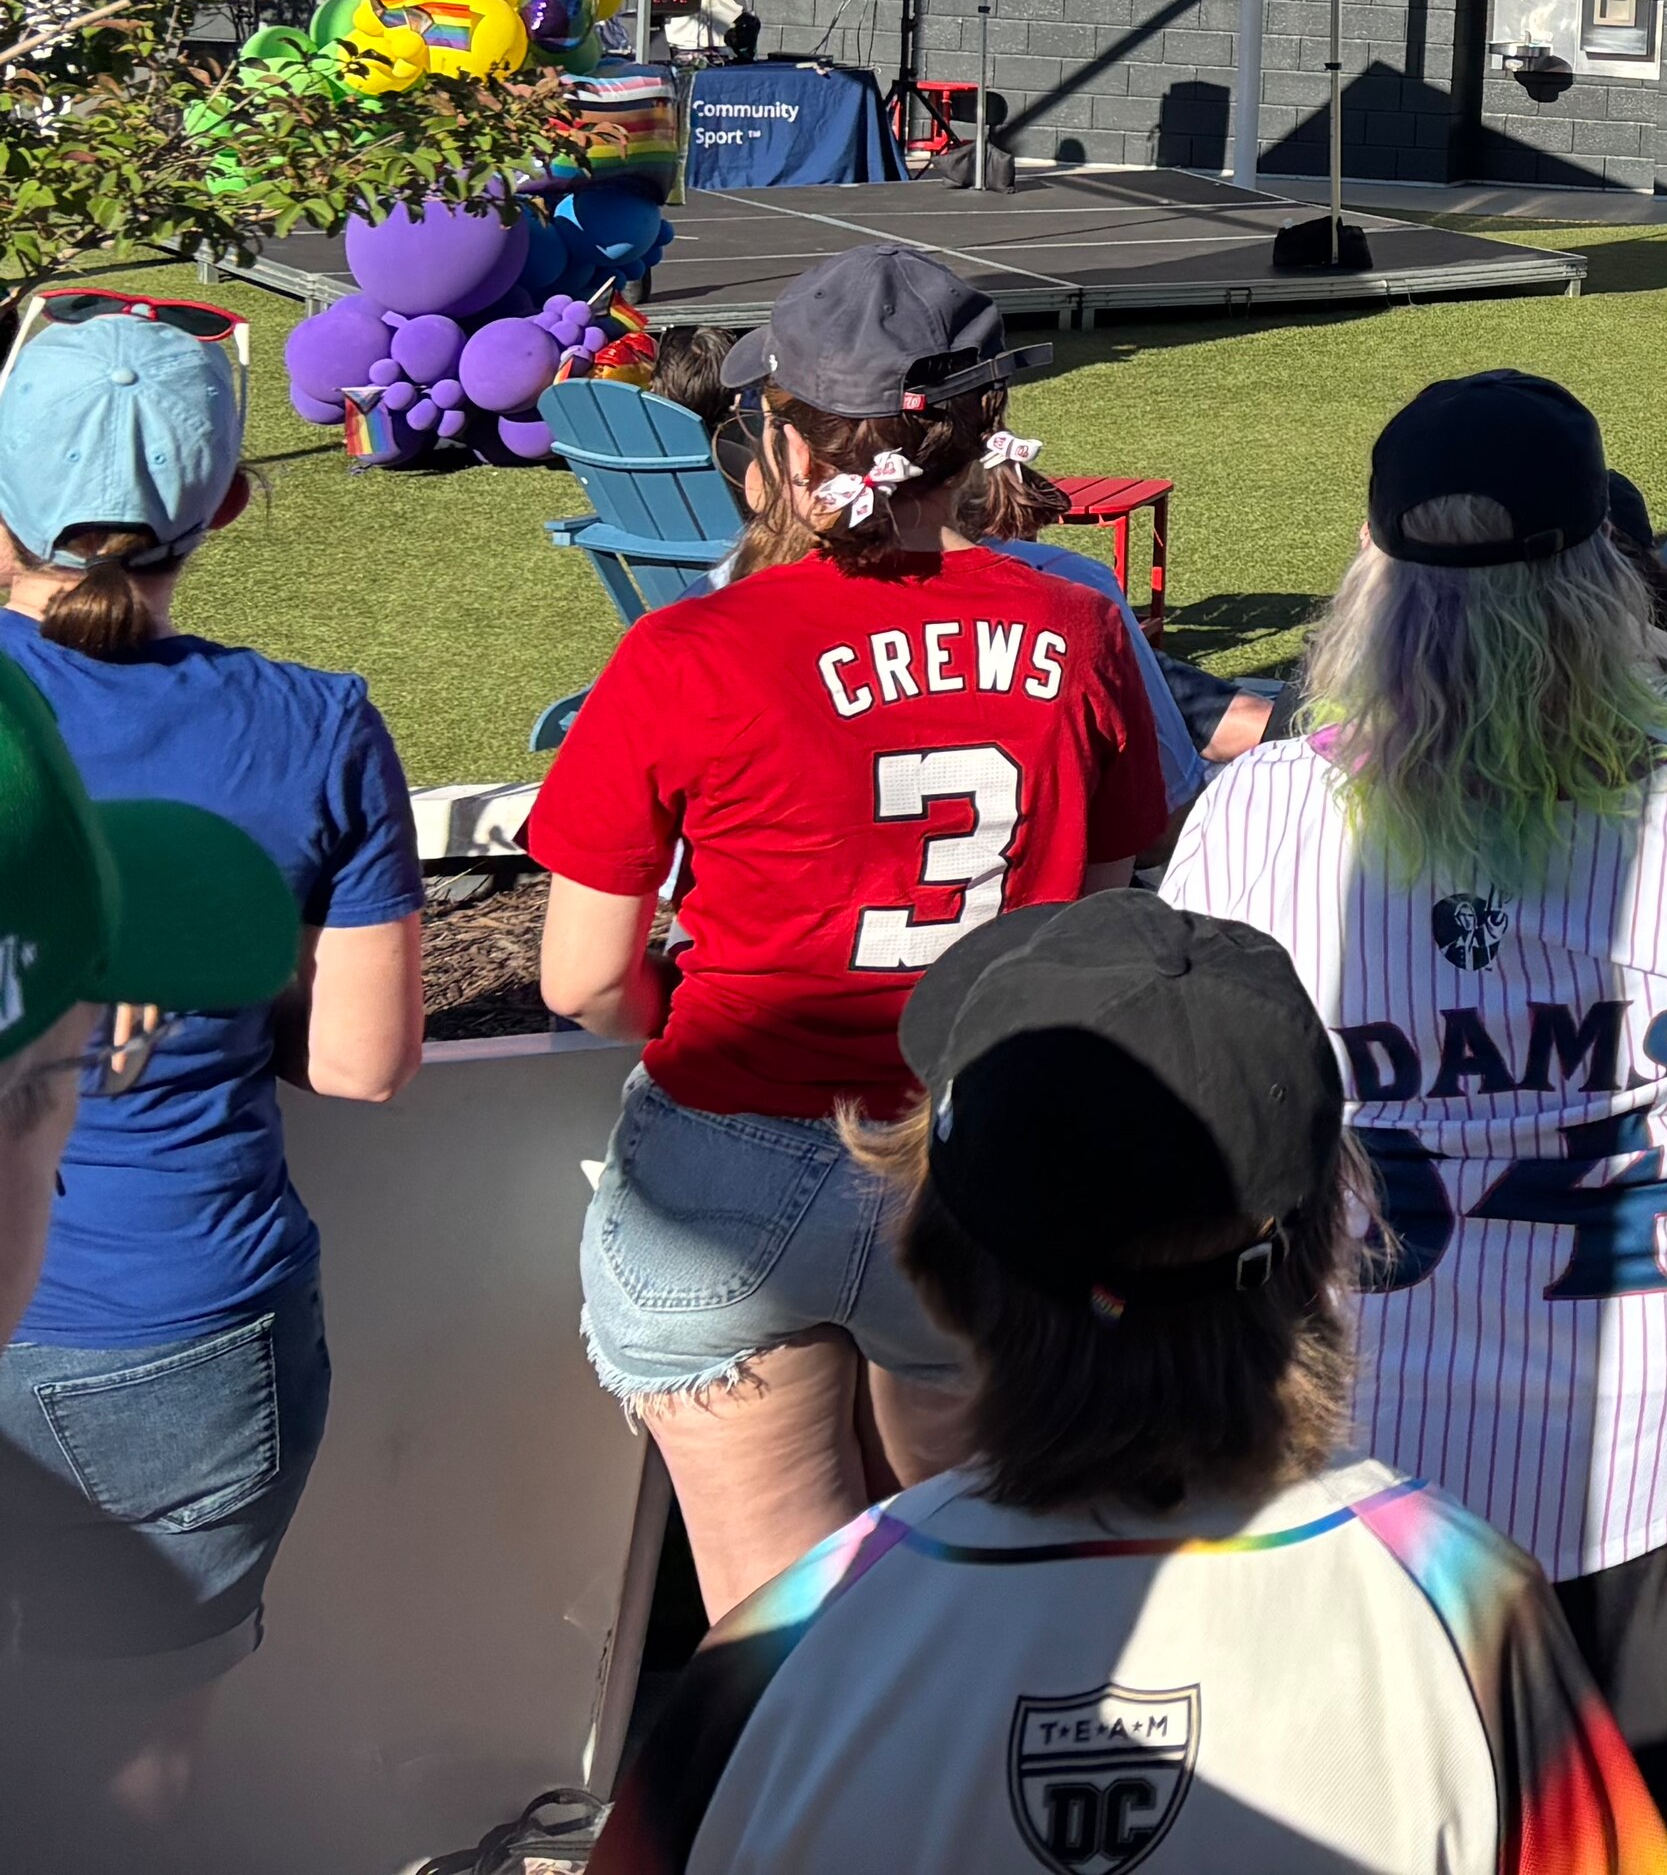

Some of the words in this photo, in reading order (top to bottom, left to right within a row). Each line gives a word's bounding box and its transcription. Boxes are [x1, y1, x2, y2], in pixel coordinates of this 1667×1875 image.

[693, 101, 798, 122] Community
[696, 128, 743, 148] Sport
[817, 620, 1067, 719] CREWS
[850, 743, 1022, 972] 3
[1044, 1777, 1157, 1863] DC
